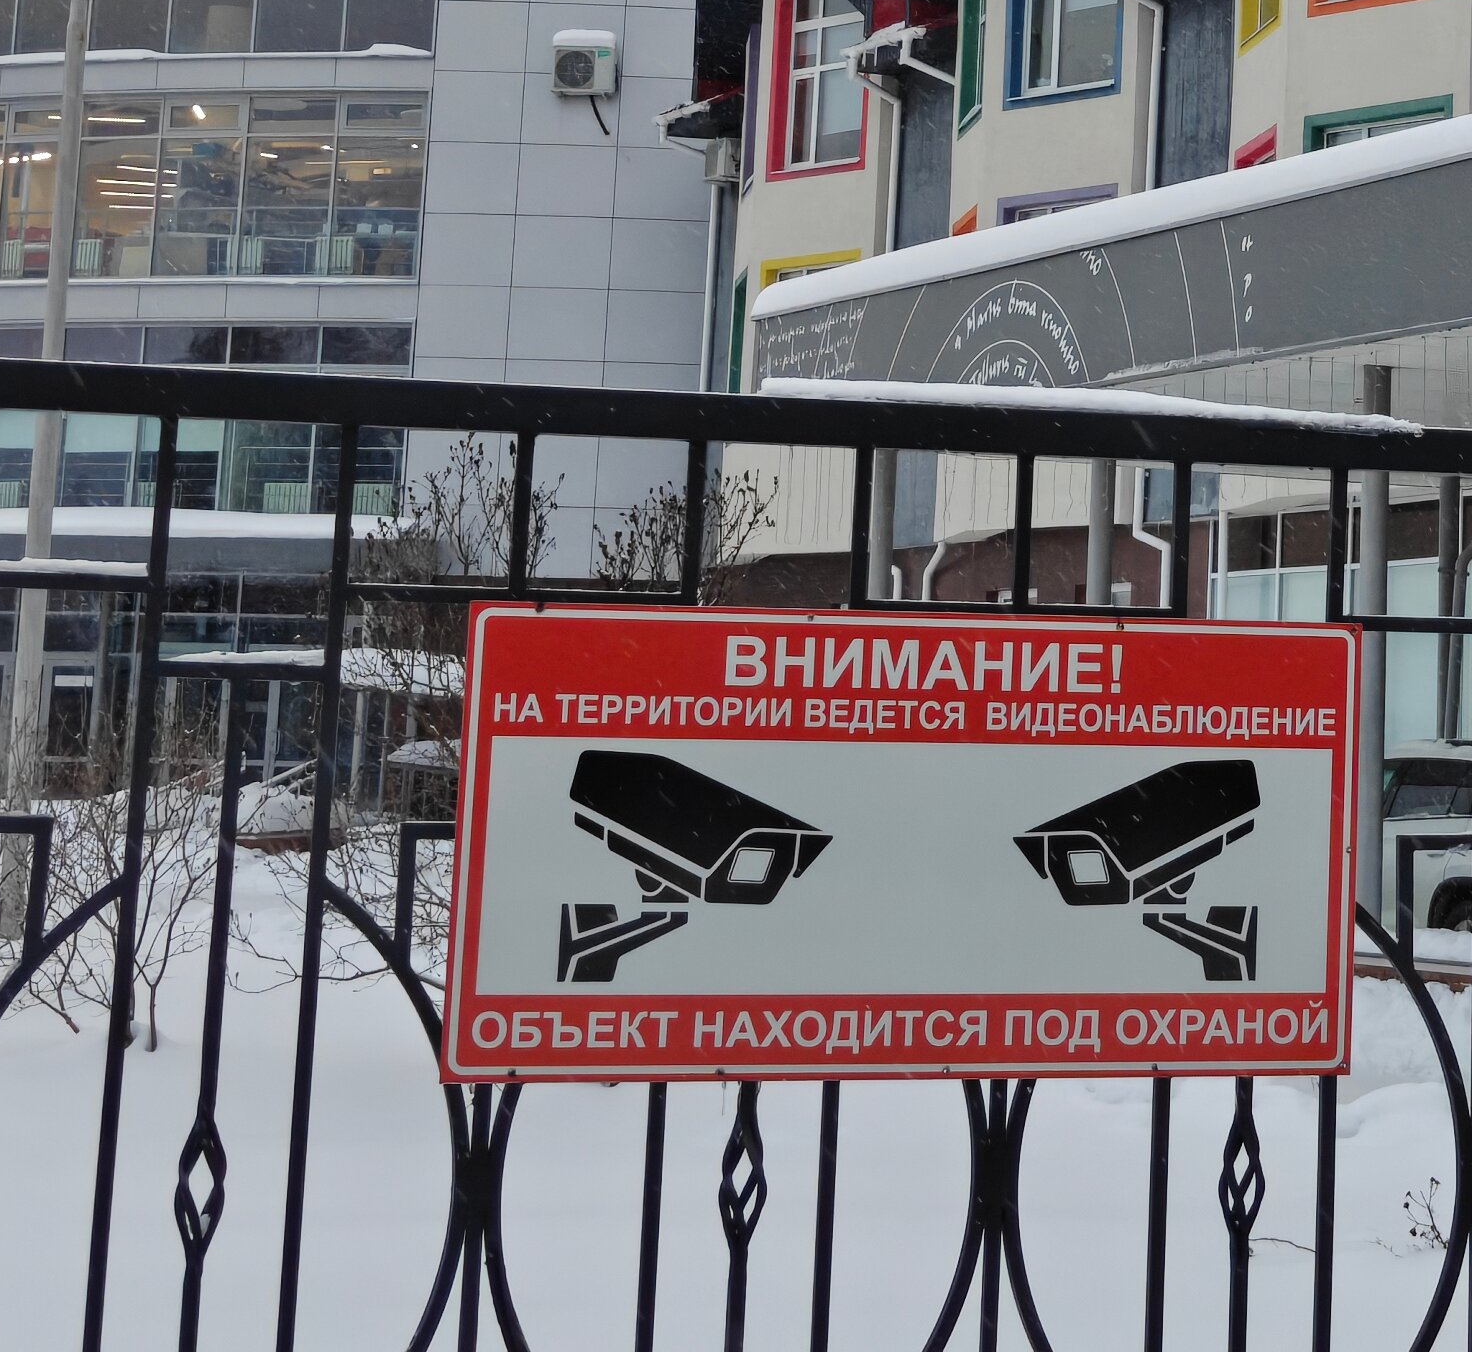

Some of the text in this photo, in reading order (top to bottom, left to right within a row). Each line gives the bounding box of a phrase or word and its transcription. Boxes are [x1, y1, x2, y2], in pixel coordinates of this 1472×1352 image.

[723, 635, 1124, 695] ВНИМАНИЕ!
[493, 693, 1337, 740] НА ТЕРРИТОРИИ ВЕДЕТСЯ ВИДЕОНАБЛЮДЕНИЕ
[470, 999, 1329, 1053] ОБЪЕКТ НАХОДИТСЯ ПОД ОХРАНОЙ
